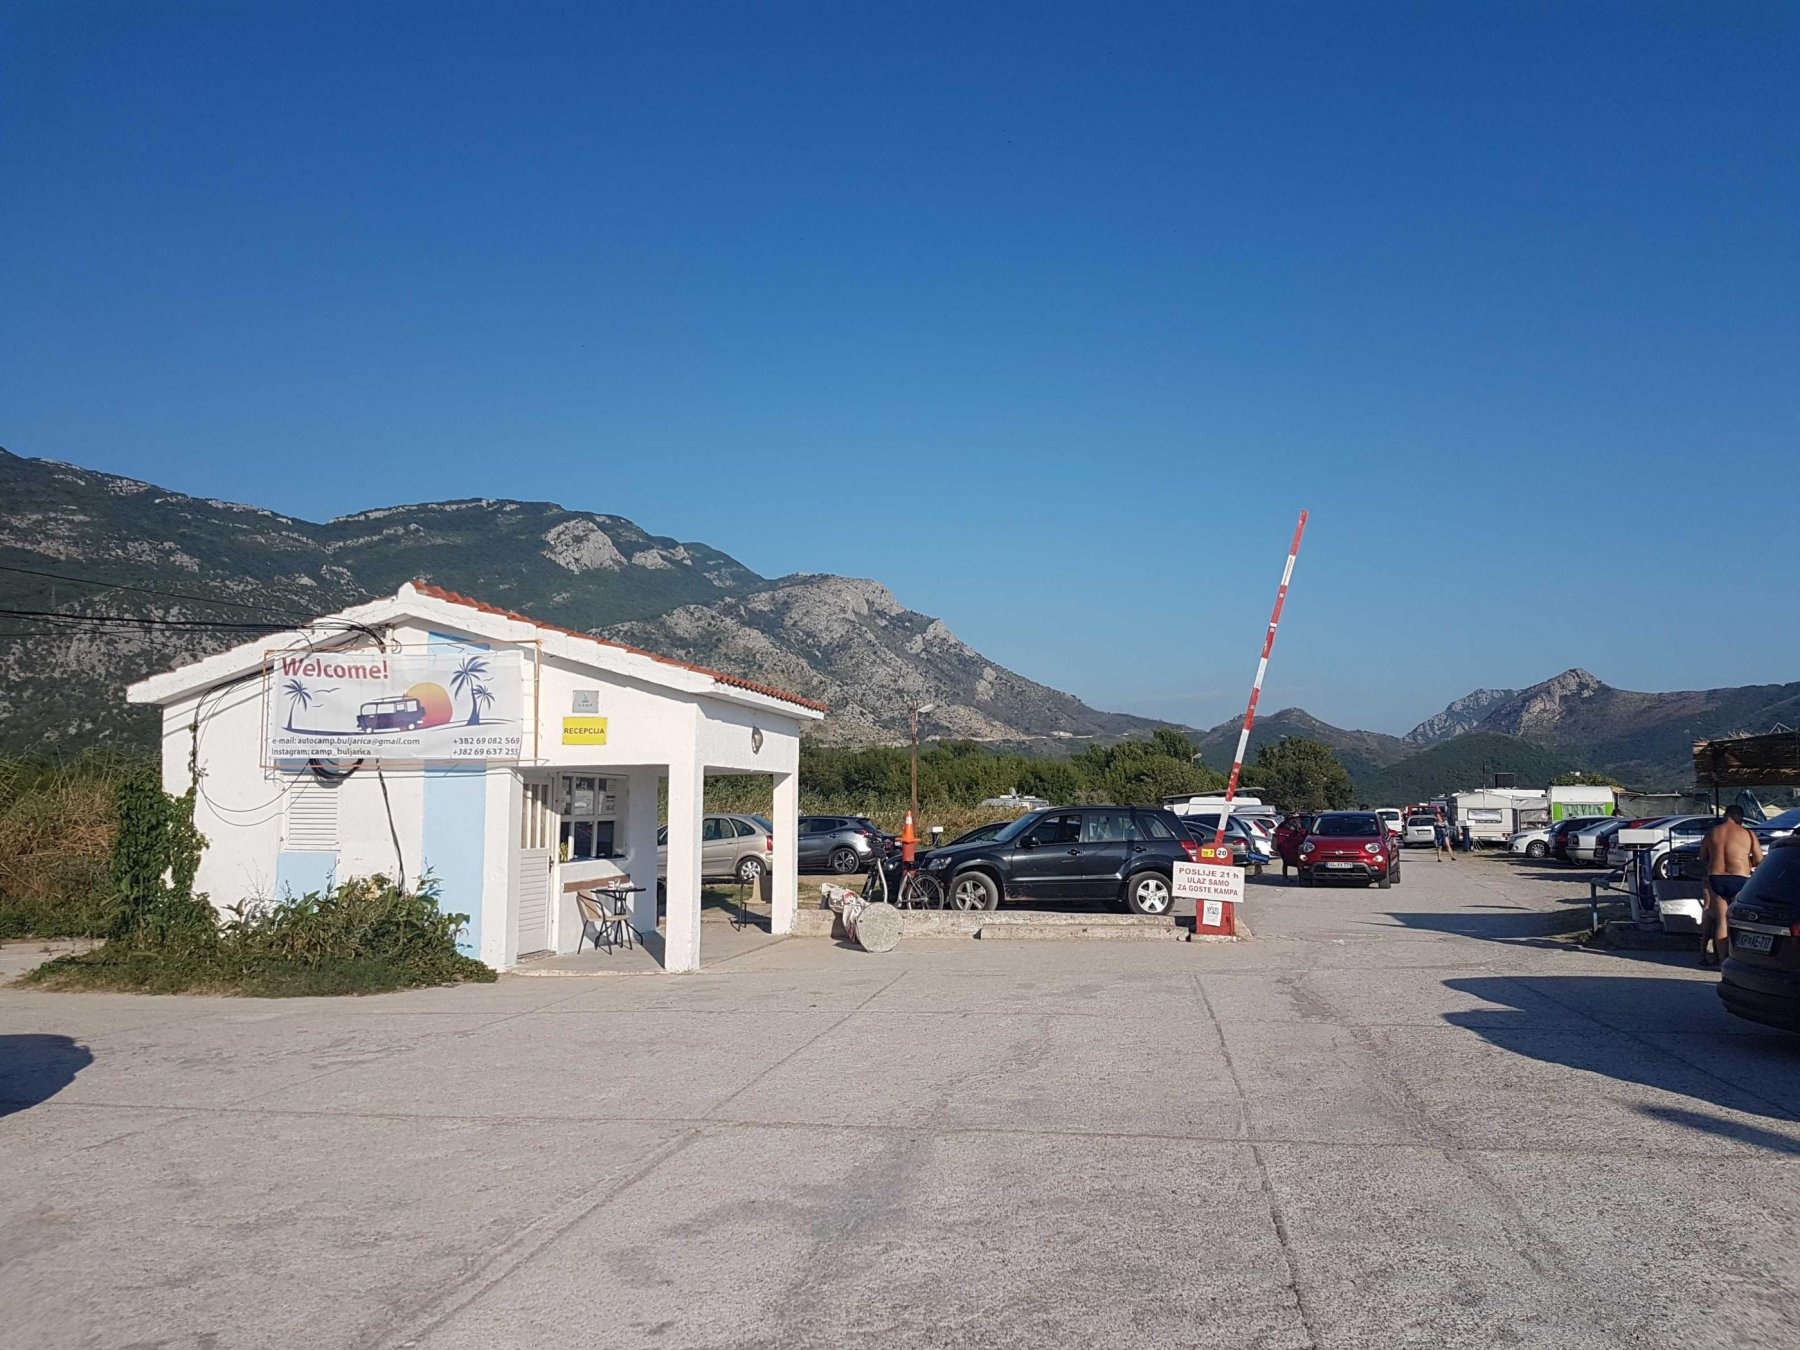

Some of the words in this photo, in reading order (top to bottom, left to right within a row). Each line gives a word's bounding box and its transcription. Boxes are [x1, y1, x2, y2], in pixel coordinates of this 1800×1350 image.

[281, 657, 388, 680] Welcome!
[563, 727, 605, 735] RECEPCIJA
[297, 737, 420, 746] autocamp.buljarica@gmail.com
[1179, 868, 1217, 877] POSLIJE
[1208, 879, 1229, 887] SAMO
[1188, 885, 1212, 893] GOSTE
[1214, 887, 1238, 896] KAMPA
